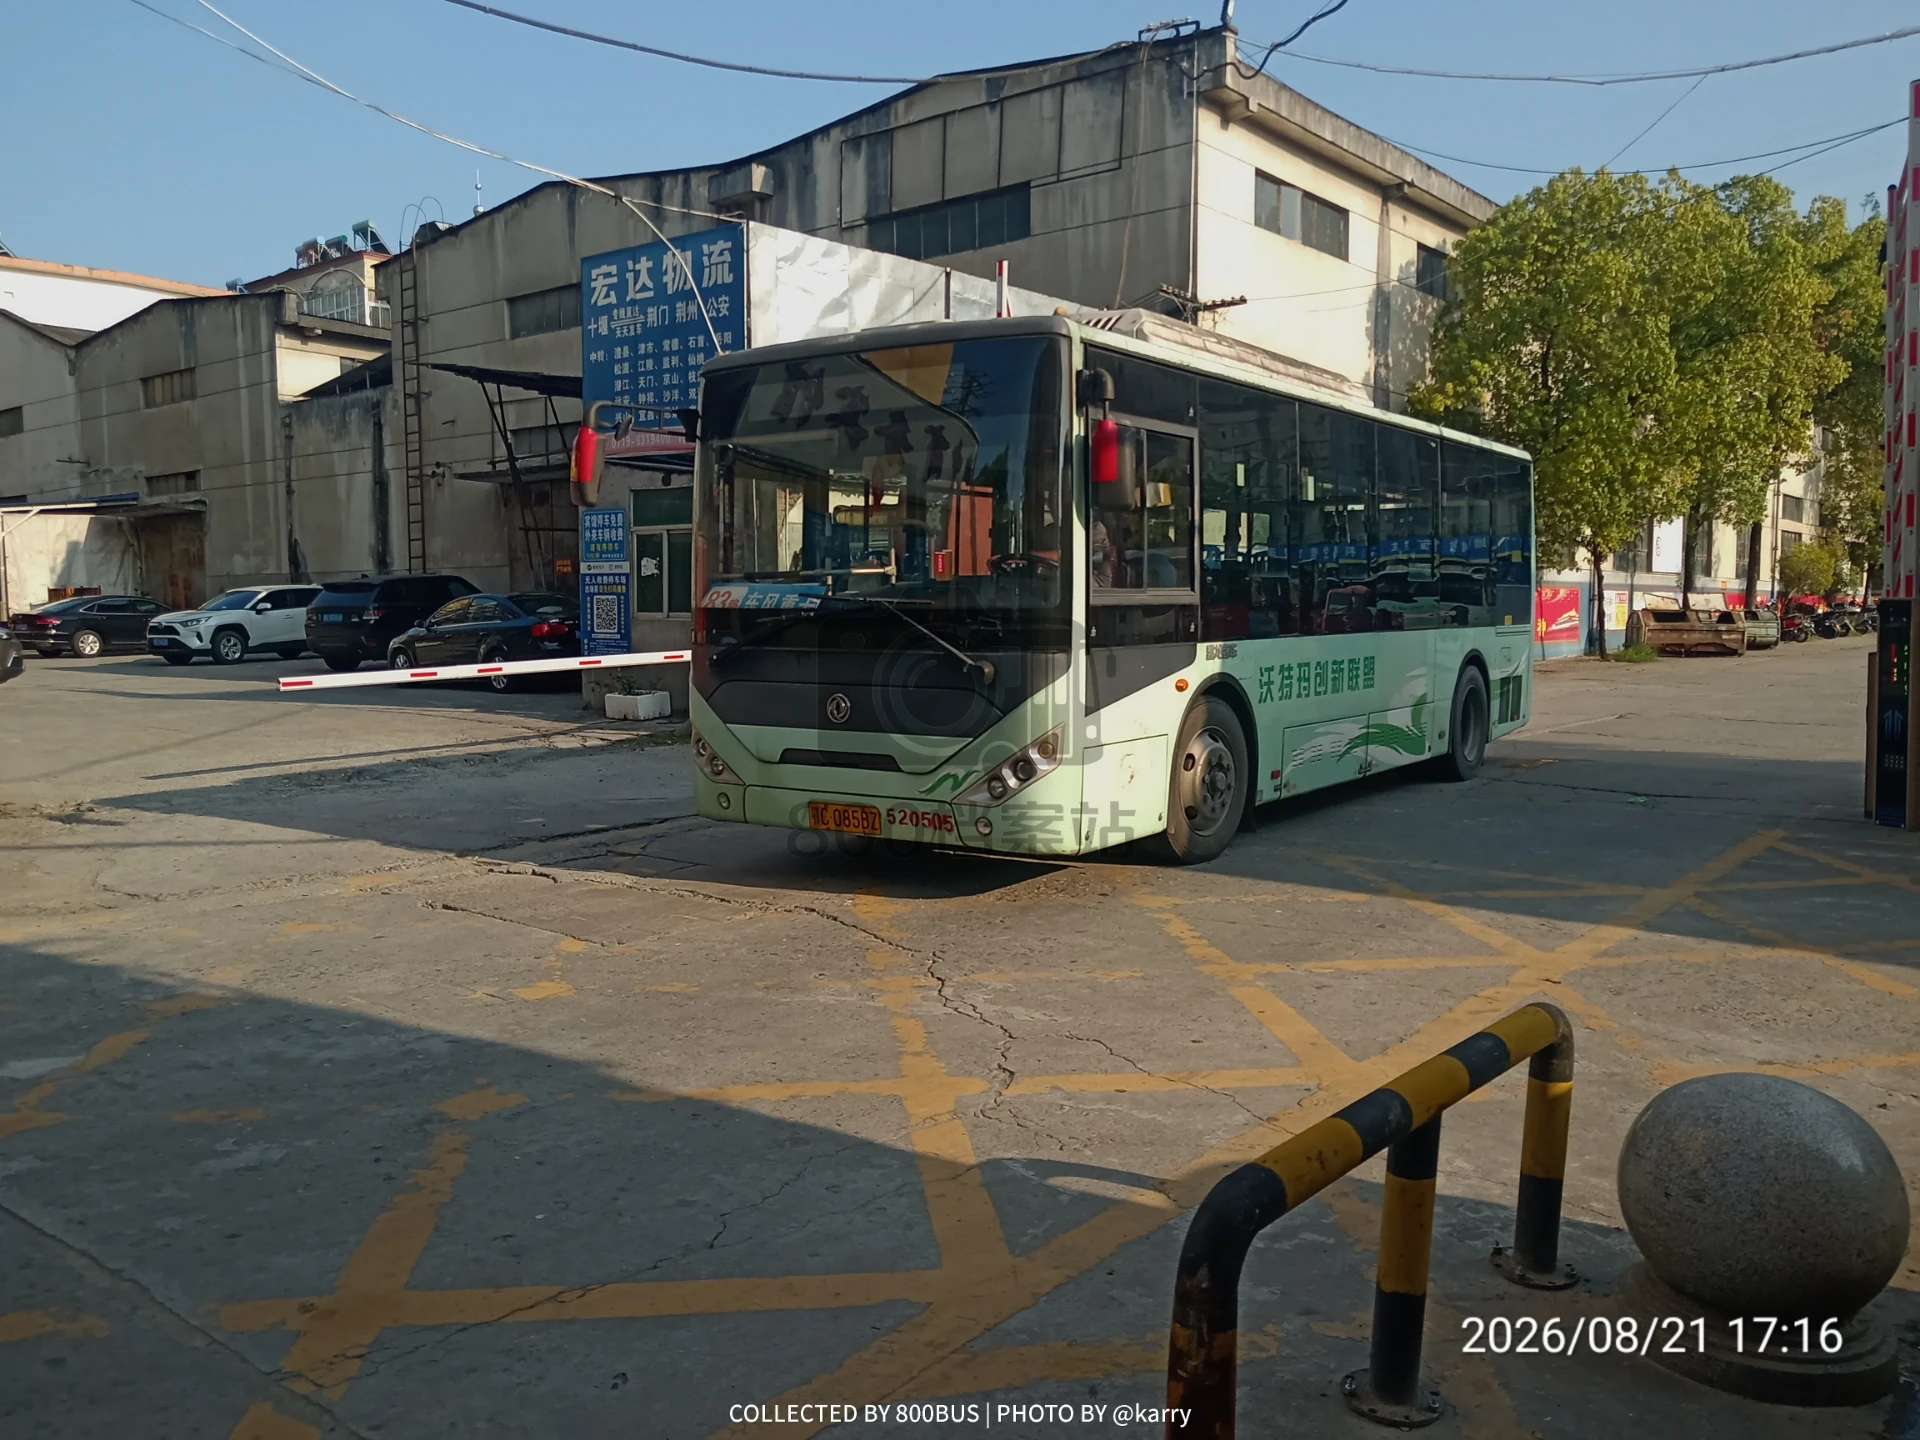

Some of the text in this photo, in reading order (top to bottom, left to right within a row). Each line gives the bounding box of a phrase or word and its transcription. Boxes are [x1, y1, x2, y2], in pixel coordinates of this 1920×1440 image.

[590, 240, 734, 307] 宏达物流
[587, 294, 730, 339] 十堰 荆门 荆州 公安
[1257, 655, 1376, 705] 沃特玛创新联盟
[886, 807, 955, 833] 520505
